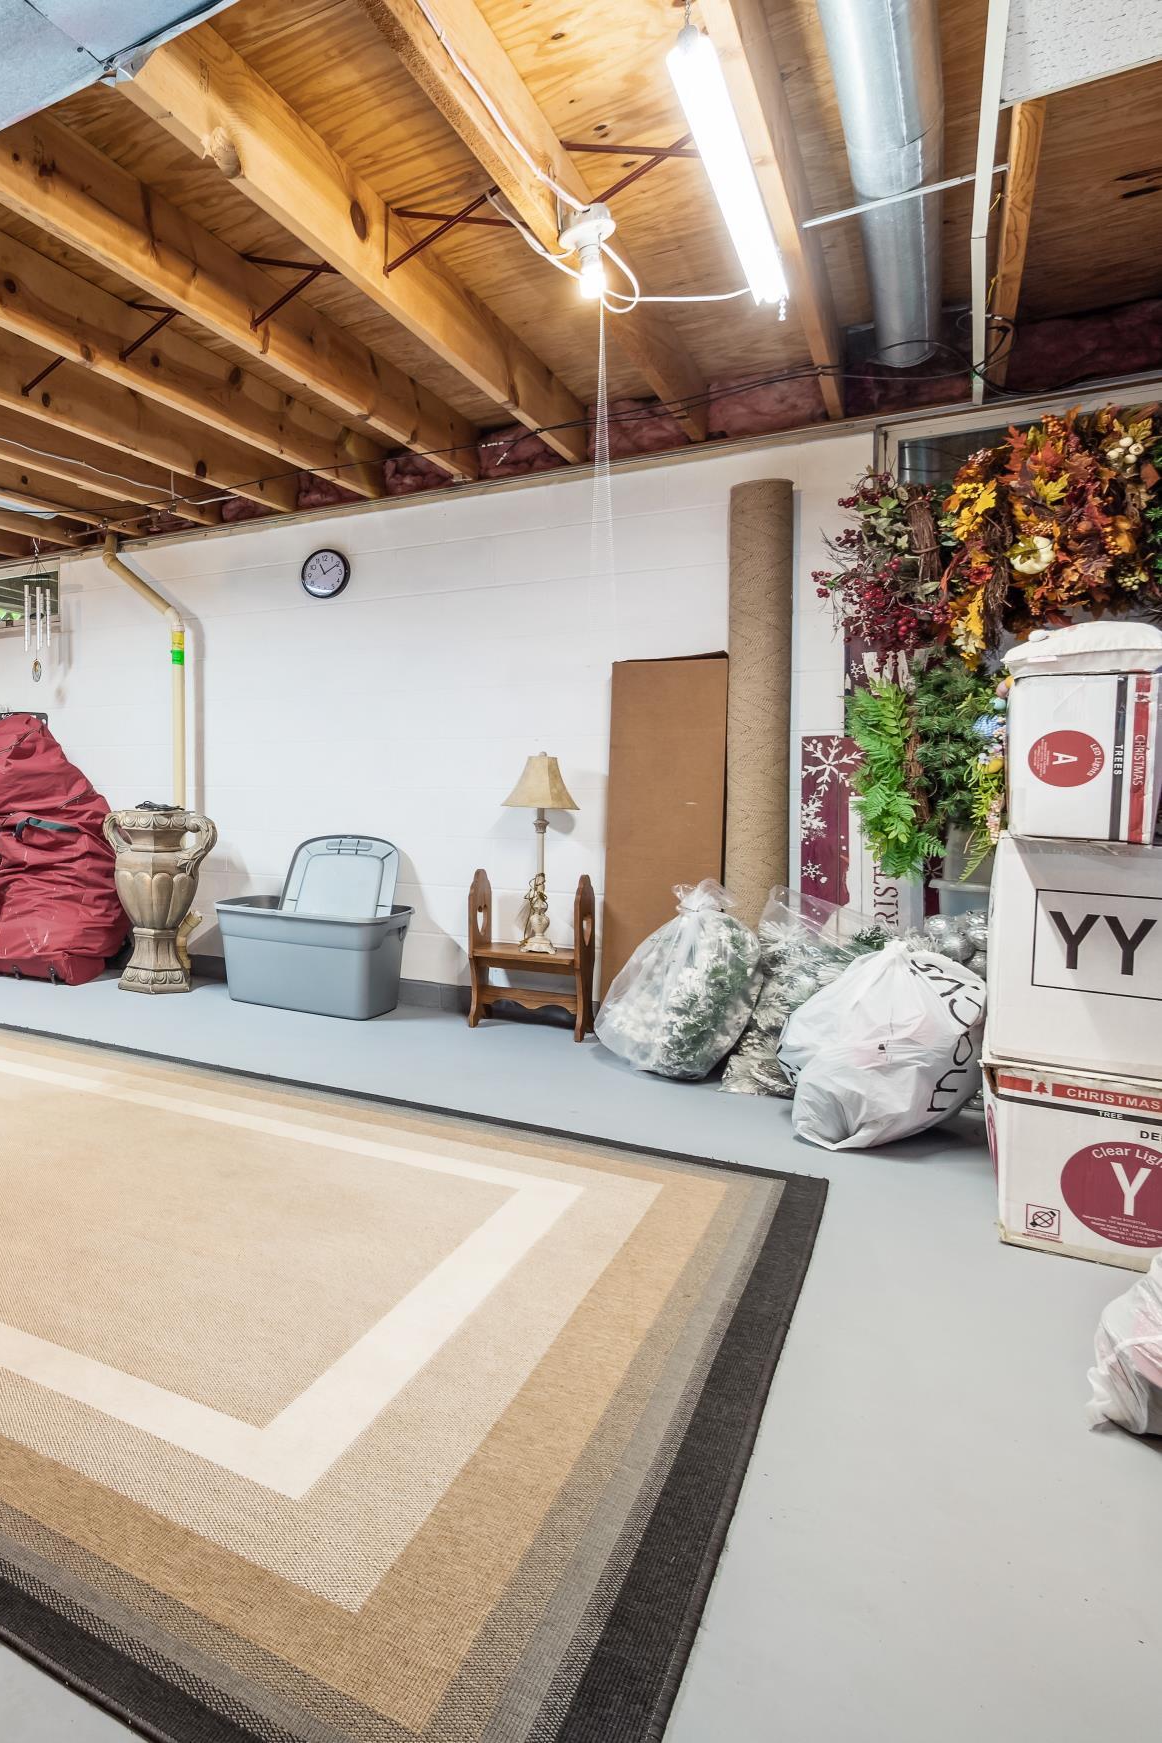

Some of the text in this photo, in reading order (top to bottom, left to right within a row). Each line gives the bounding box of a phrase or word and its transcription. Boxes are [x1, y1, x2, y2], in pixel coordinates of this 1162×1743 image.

[1052, 751, 1079, 766] A
[1113, 744, 1124, 776] TREES
[1132, 734, 1147, 787] CHRISTMAS
[1048, 910, 1158, 977] YY
[1066, 1087, 1161, 1111] CHRISTMAS
[1097, 1110, 1124, 1120] TREE
[1139, 1130, 1162, 1143] DE
[1091, 1146, 1131, 1160] Clear
[1109, 1161, 1152, 1217] Y
